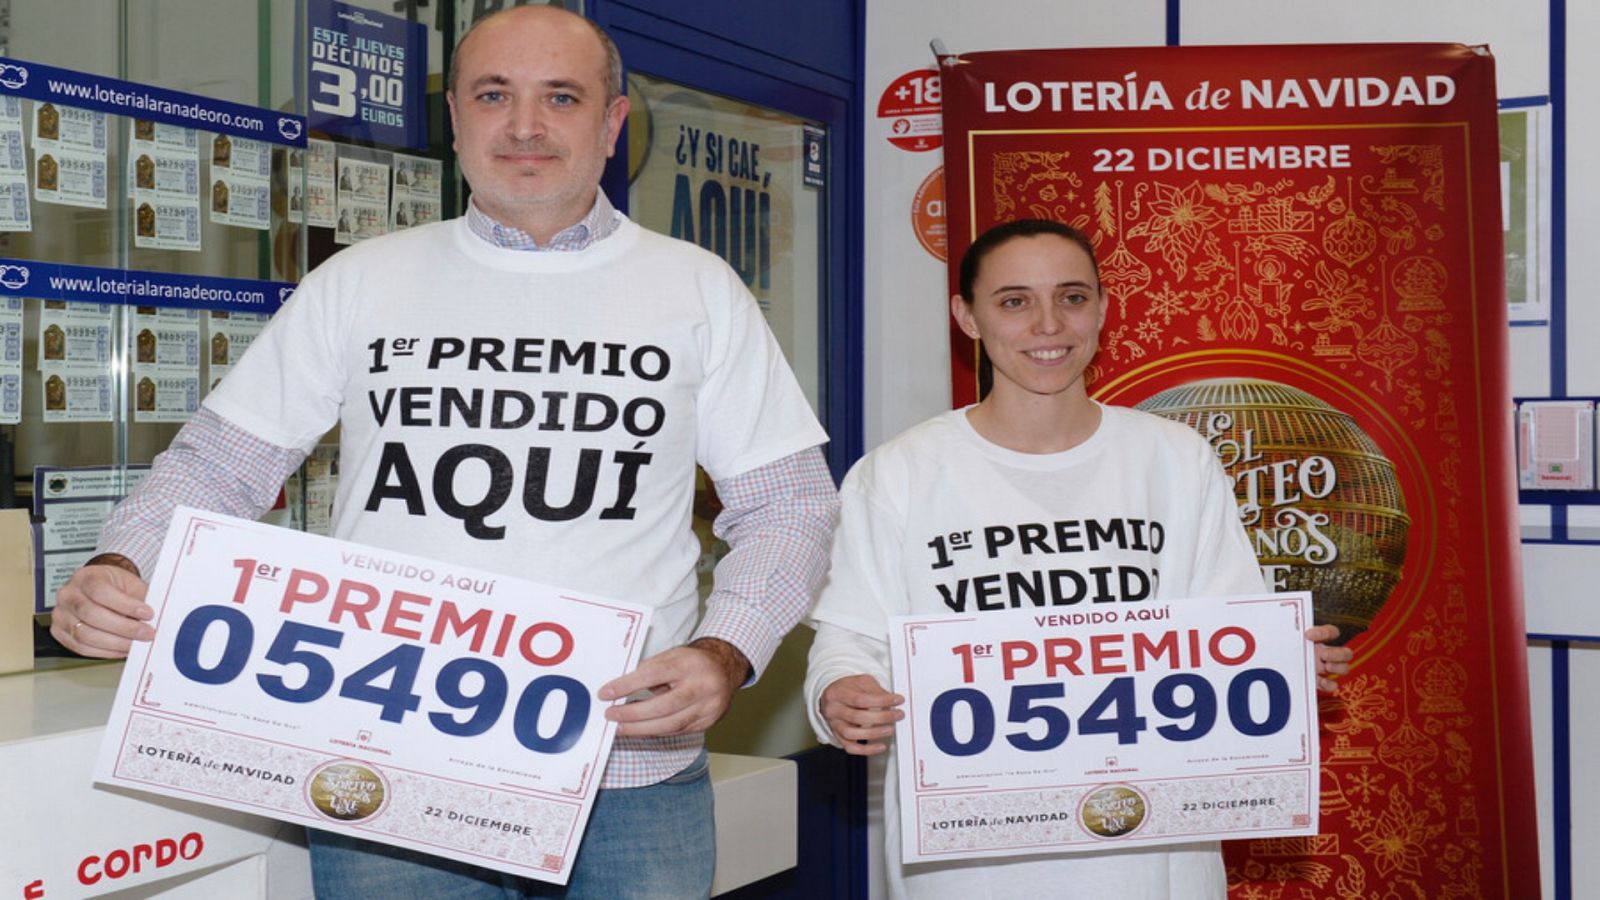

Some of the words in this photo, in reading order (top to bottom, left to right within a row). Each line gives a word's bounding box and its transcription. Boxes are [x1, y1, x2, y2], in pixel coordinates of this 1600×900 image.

[312, 41, 404, 77] DÉCIMOS
[313, 26, 348, 47] ESTE
[353, 37, 404, 60] JUEVES
[48, 78, 264, 131] www.loterialaranadeoro.com
[895, 76, 941, 104] +18
[985, 71, 1174, 113] LOTERÍA
[1185, 81, 1231, 111] de
[1241, 75, 1456, 110] NAVIDAD
[361, 107, 404, 128] EUROS
[705, 132, 723, 173] SI
[728, 138, 760, 182] CAE
[1092, 148, 1135, 172] 22
[1148, 145, 1351, 172] DICIEMBRE
[49, 275, 265, 305] www.loterialaranadeoro.com
[367, 337, 420, 374] 1er
[427, 337, 671, 382] PREMIO
[368, 386, 666, 437] VENDIDO
[364, 441, 653, 540] AQUÍ
[927, 529, 973, 570] 1er
[340, 550, 435, 584] VENDIDO
[441, 572, 497, 596] AQUÍ
[935, 565, 1160, 613] VENDID
[232, 558, 282, 604] 1er
[279, 567, 575, 667] PREMIO
[1035, 611, 1118, 628] VENDIDO
[1124, 605, 1170, 622] AQUÍ
[951, 642, 994, 684] 1er
[1000, 626, 1256, 681] PREMIO
[172, 604, 591, 755] 05490
[929, 667, 1292, 757] 05490
[137, 743, 201, 767] LOTERÍA
[222, 762, 295, 786] NAVIDAD
[424, 806, 442, 818] 22
[447, 809, 533, 836] DICIEMBRE
[932, 817, 988, 830] LOTERÍA
[1005, 812, 1069, 825] NAVIDAD
[1182, 803, 1198, 811] 22
[1202, 797, 1276, 811] DICIEMBRE
